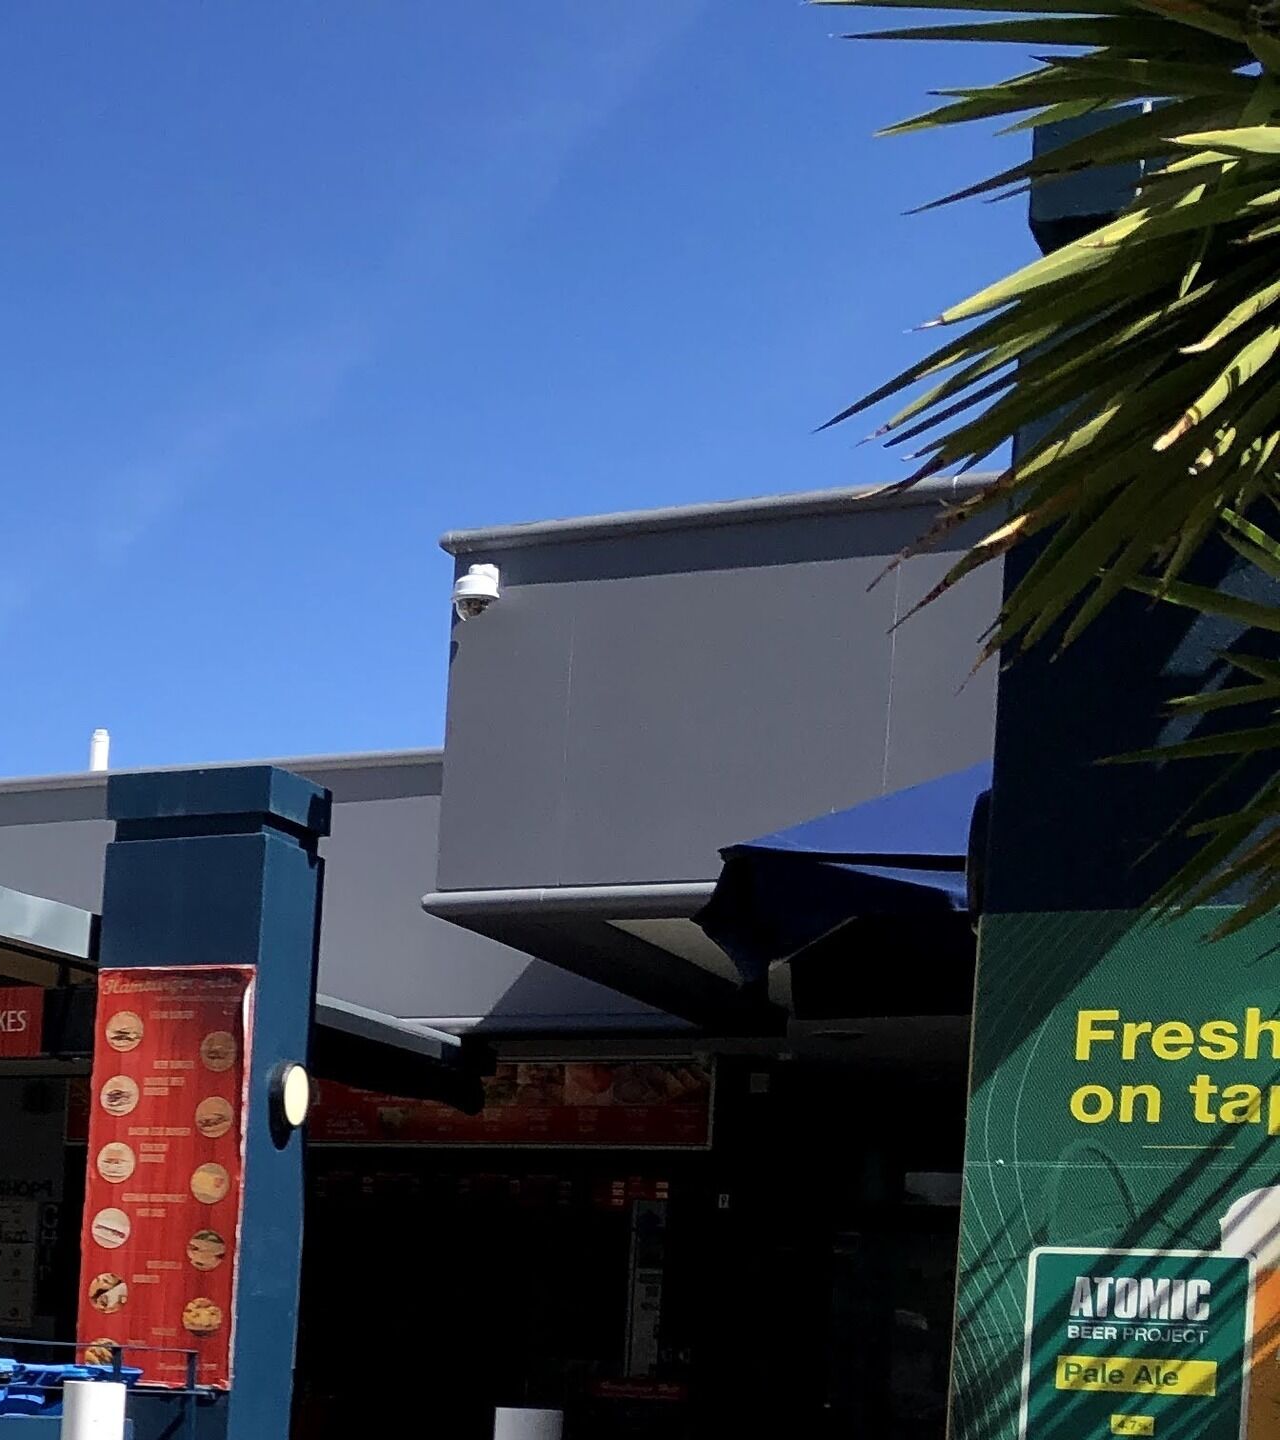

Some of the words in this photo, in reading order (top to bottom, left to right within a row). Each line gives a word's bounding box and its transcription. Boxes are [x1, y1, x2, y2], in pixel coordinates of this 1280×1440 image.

[1075, 1007, 1280, 1061] Fresh
[1070, 1084, 1161, 1124] on
[1069, 1276, 1212, 1321] ATOMIC
[1066, 1324, 1118, 1341] BEER
[1122, 1327, 1209, 1344] PROJECT
[1064, 1363, 1126, 1385] Pale
[1132, 1365, 1180, 1387] Ale
